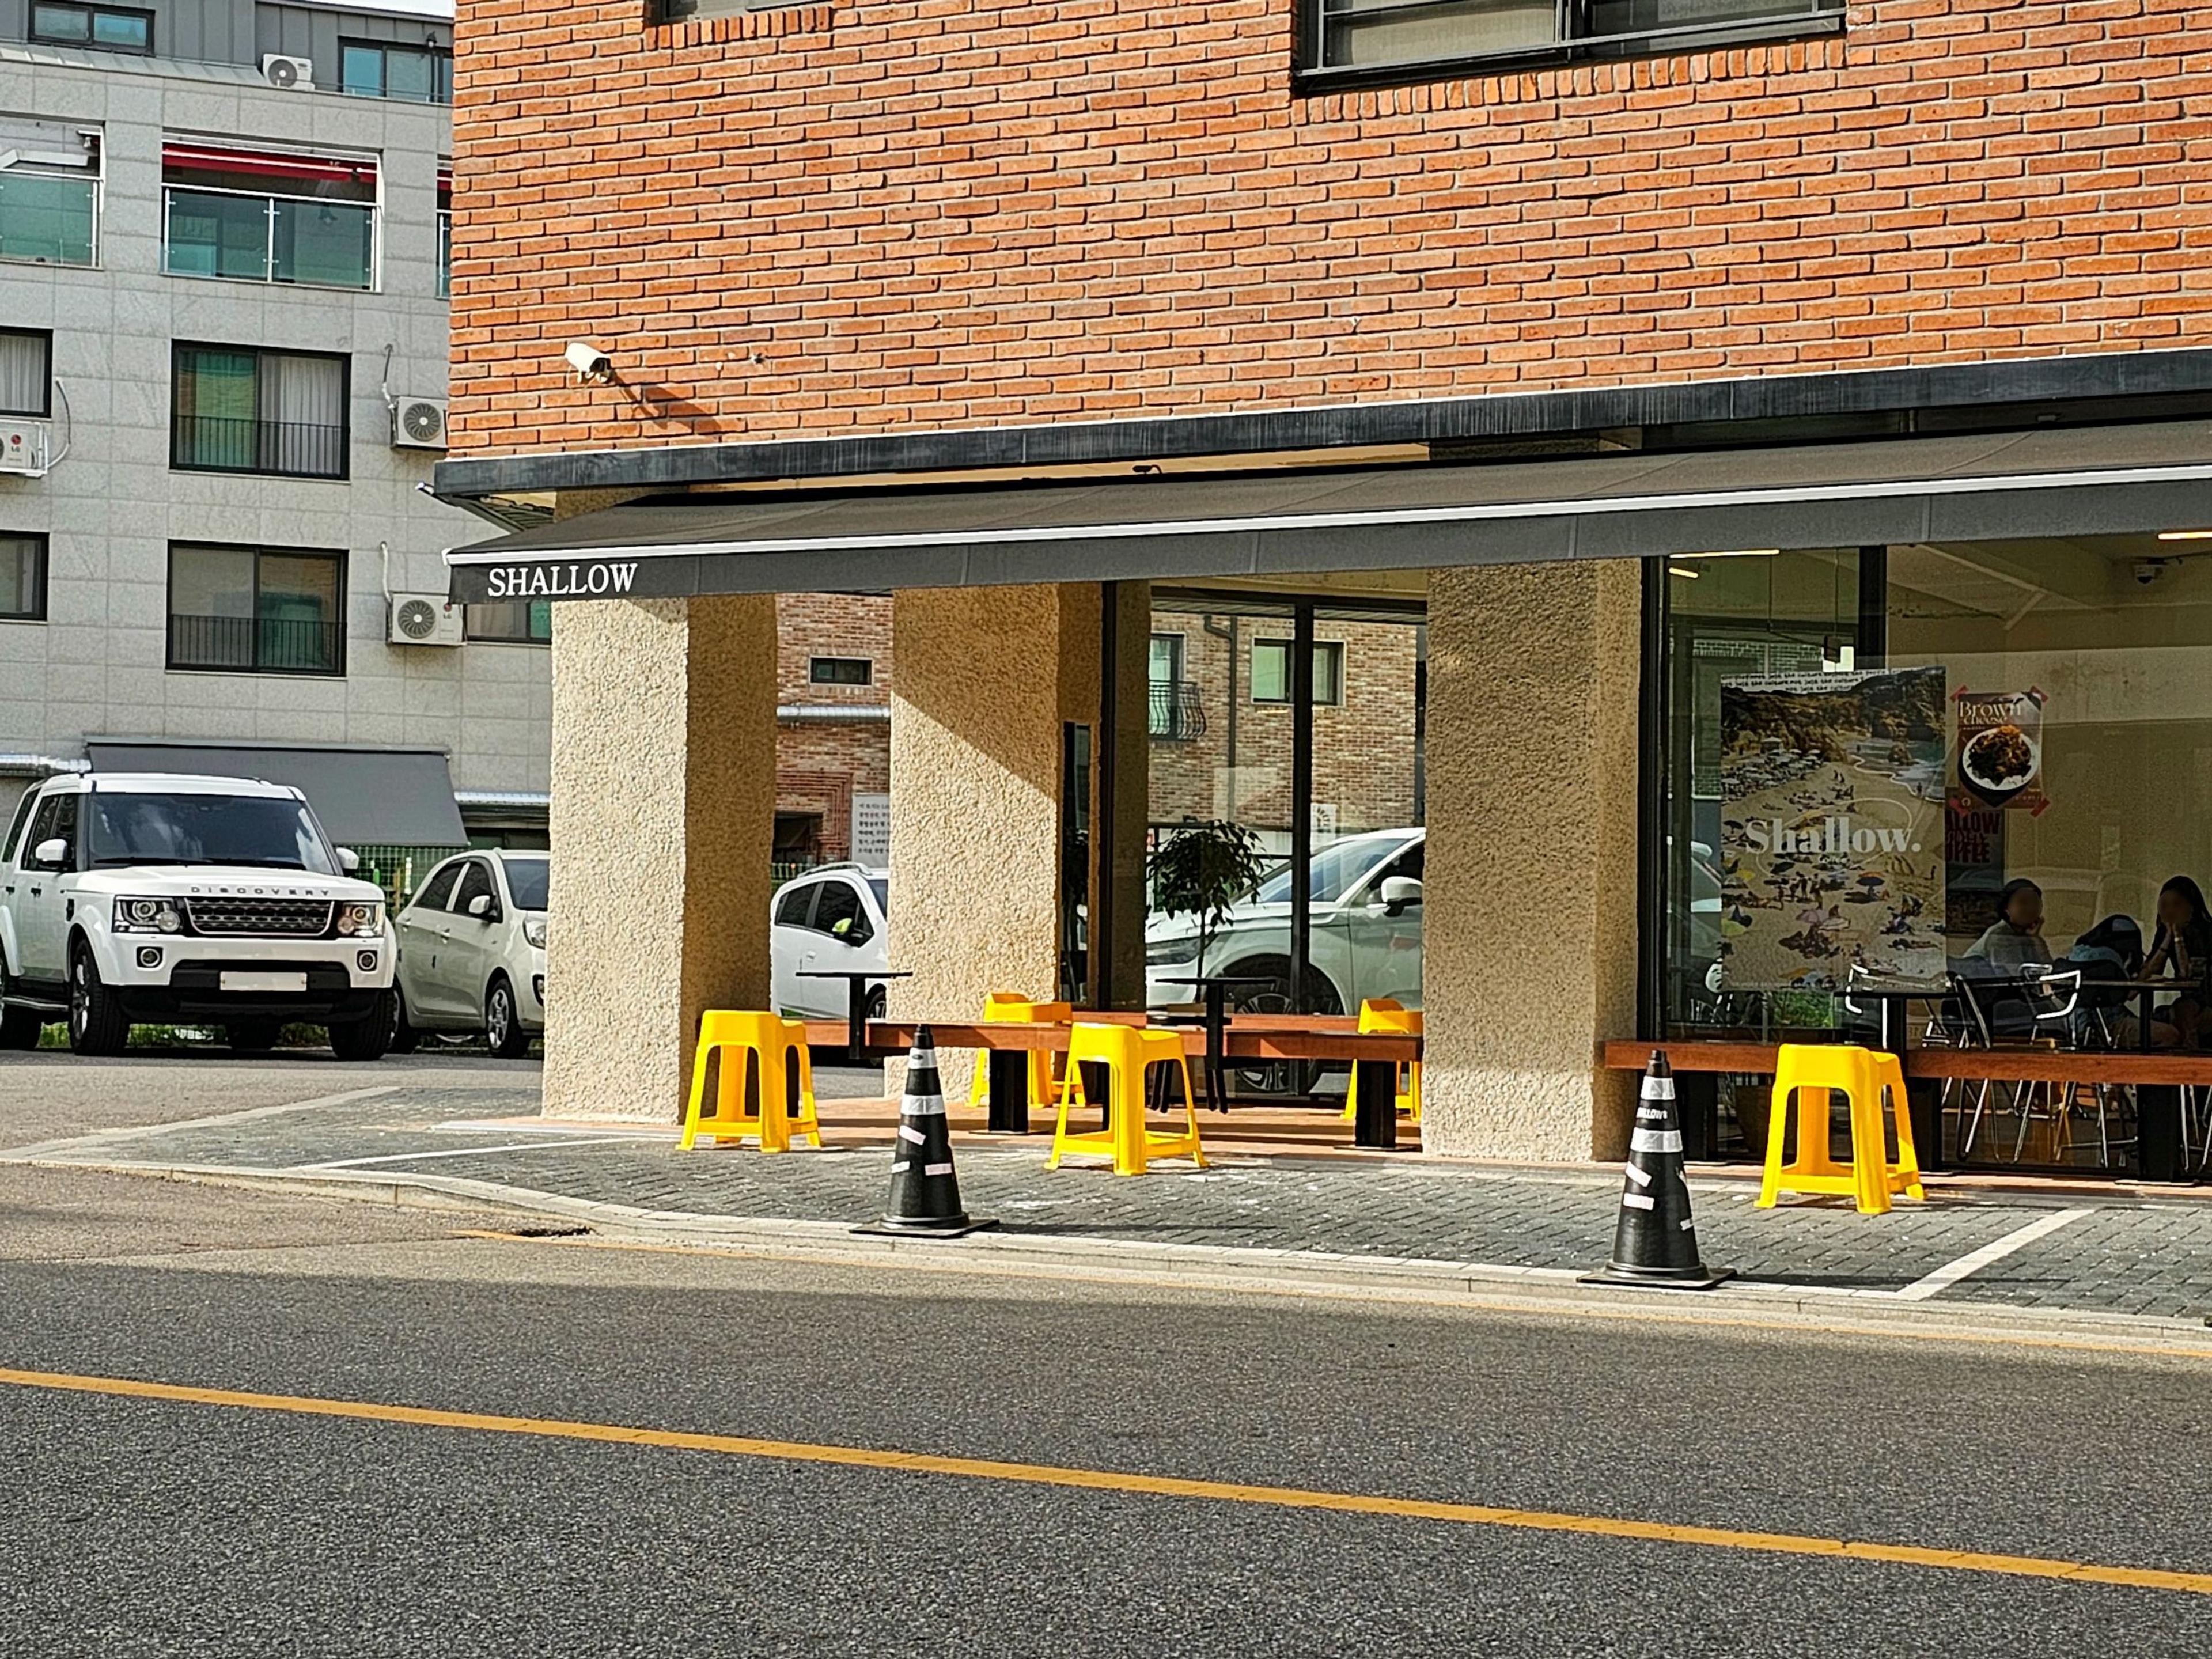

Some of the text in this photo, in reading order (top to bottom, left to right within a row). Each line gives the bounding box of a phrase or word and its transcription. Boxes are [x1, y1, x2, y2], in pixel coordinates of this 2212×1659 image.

[487, 562, 639, 597] SHALLOW
[1960, 701, 2021, 717] Brown
[1745, 816, 1922, 854] Shallow.
[191, 886, 329, 896] DISCOVERY
